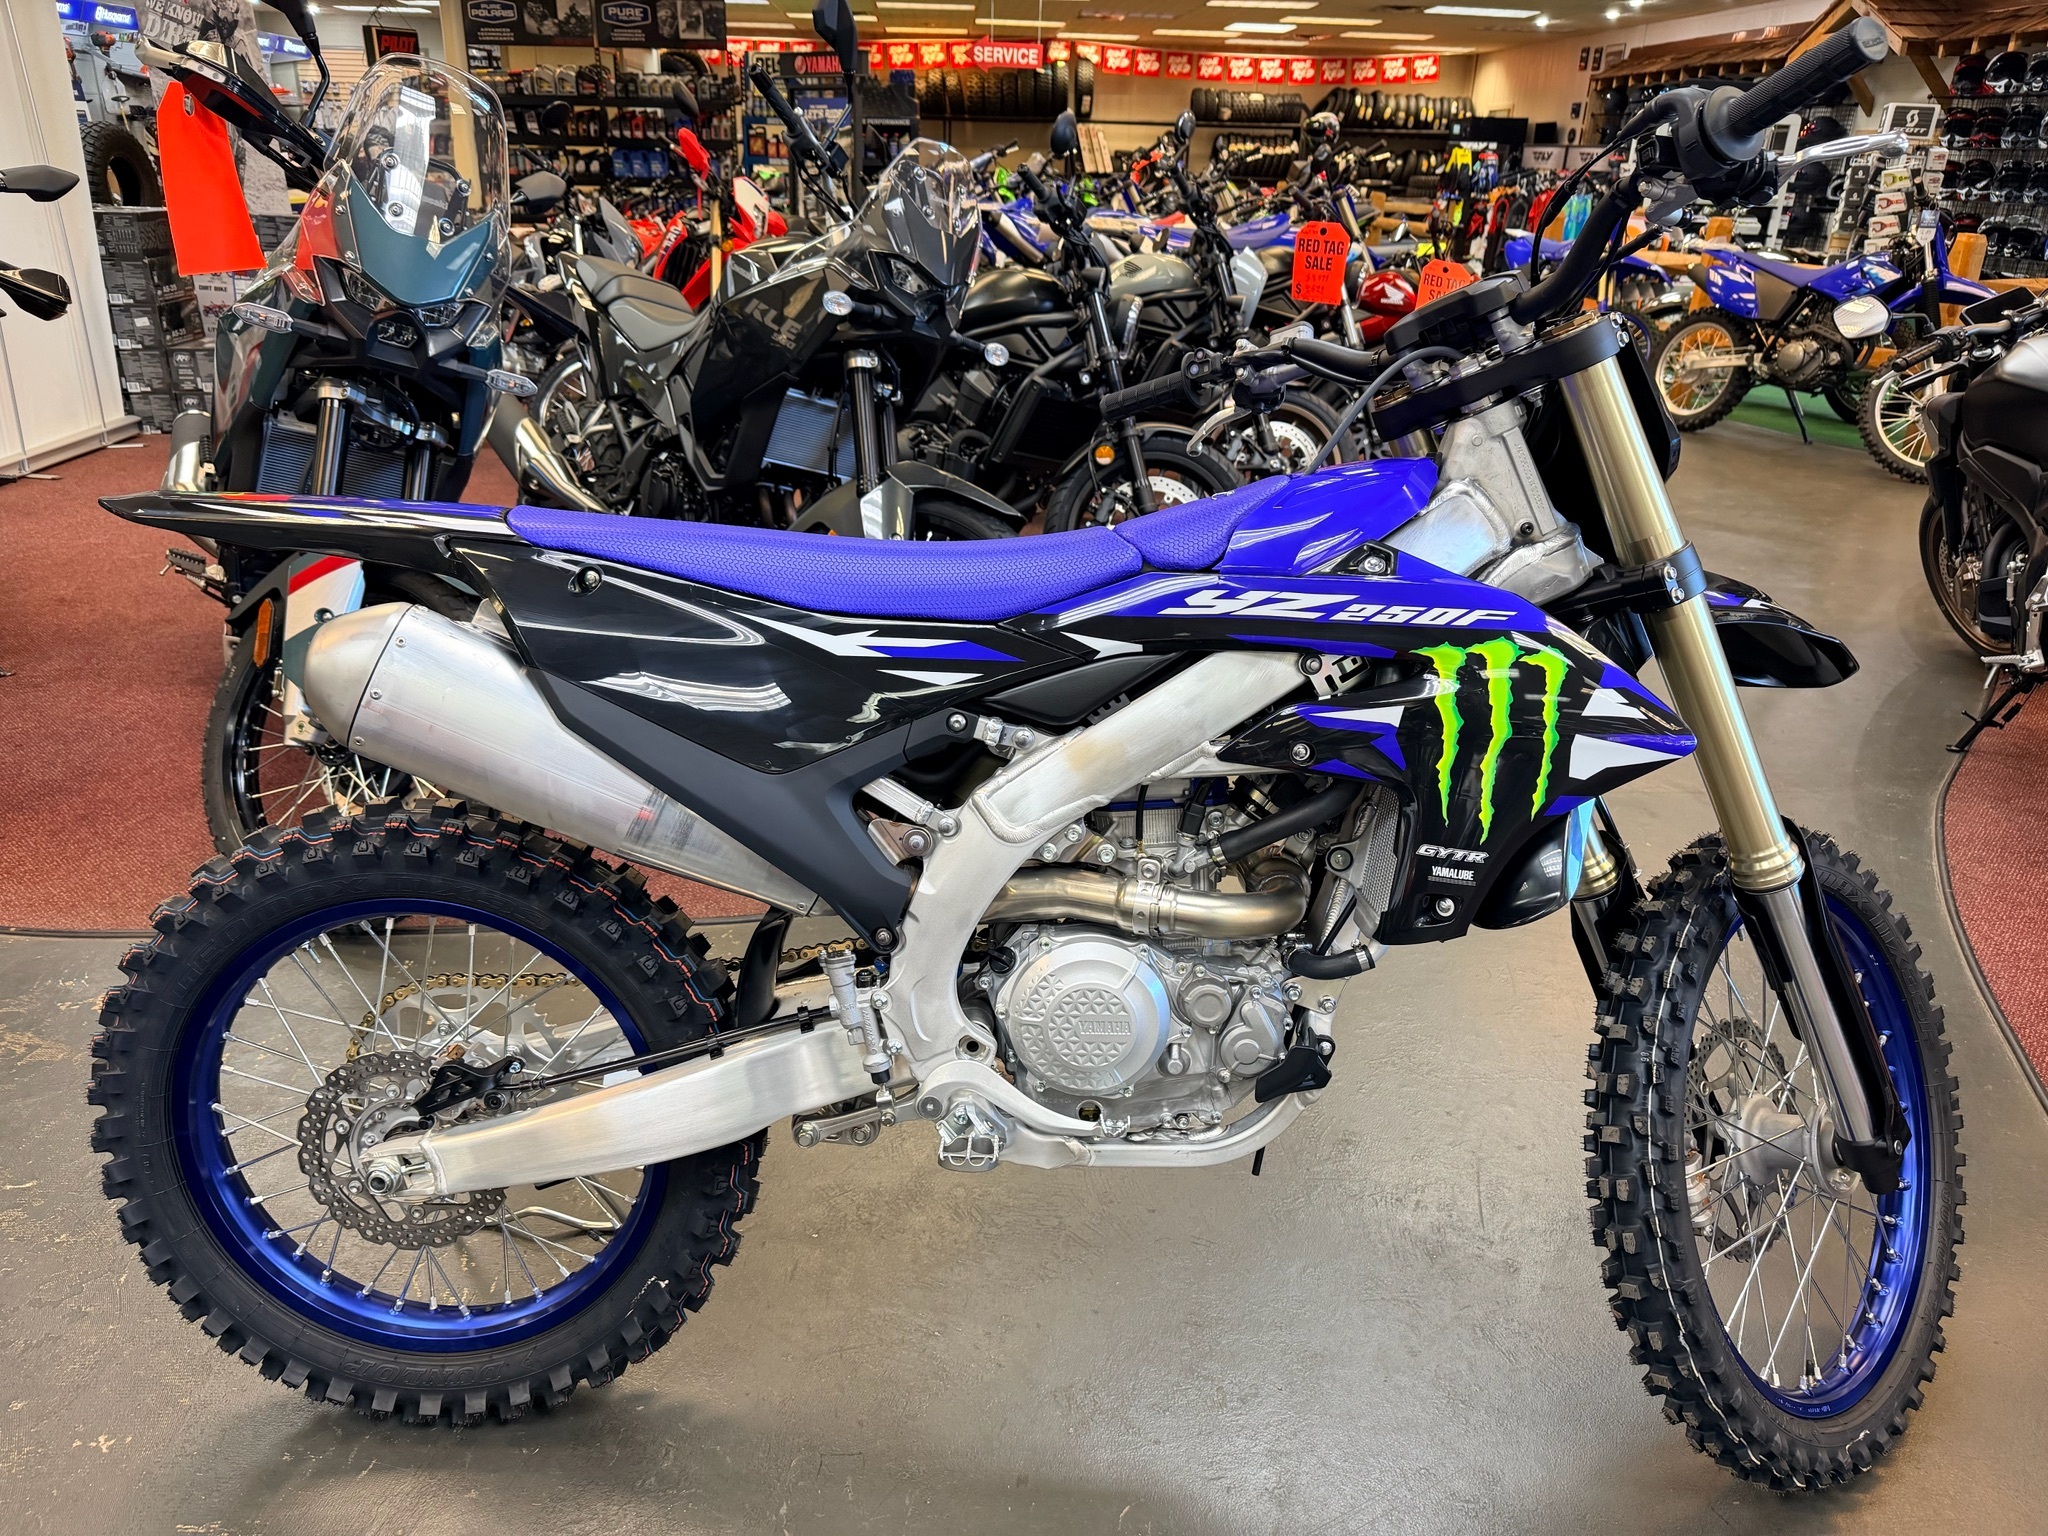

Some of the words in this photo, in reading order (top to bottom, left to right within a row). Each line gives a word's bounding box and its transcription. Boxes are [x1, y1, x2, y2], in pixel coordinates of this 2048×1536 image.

[165, 2, 204, 27] KNOW
[471, 9, 515, 17] POLARIS
[608, 7, 644, 16] PURE
[380, 35, 416, 52] PILOT
[805, 55, 842, 73] YAMAH
[973, 46, 1038, 65] SERVICE
[1298, 238, 1320, 253] RED
[1324, 240, 1345, 255] TAG
[1305, 255, 1333, 271] SALE
[1295, 283, 1302, 294] $
[1423, 273, 1443, 287] RED
[743, 298, 802, 341] KLE
[1415, 843, 1490, 864] GYTR
[1431, 865, 1475, 881] YAMALUBE
[1078, 1020, 1132, 1035] YAMAHA
[340, 1358, 505, 1387] DUNLOP
